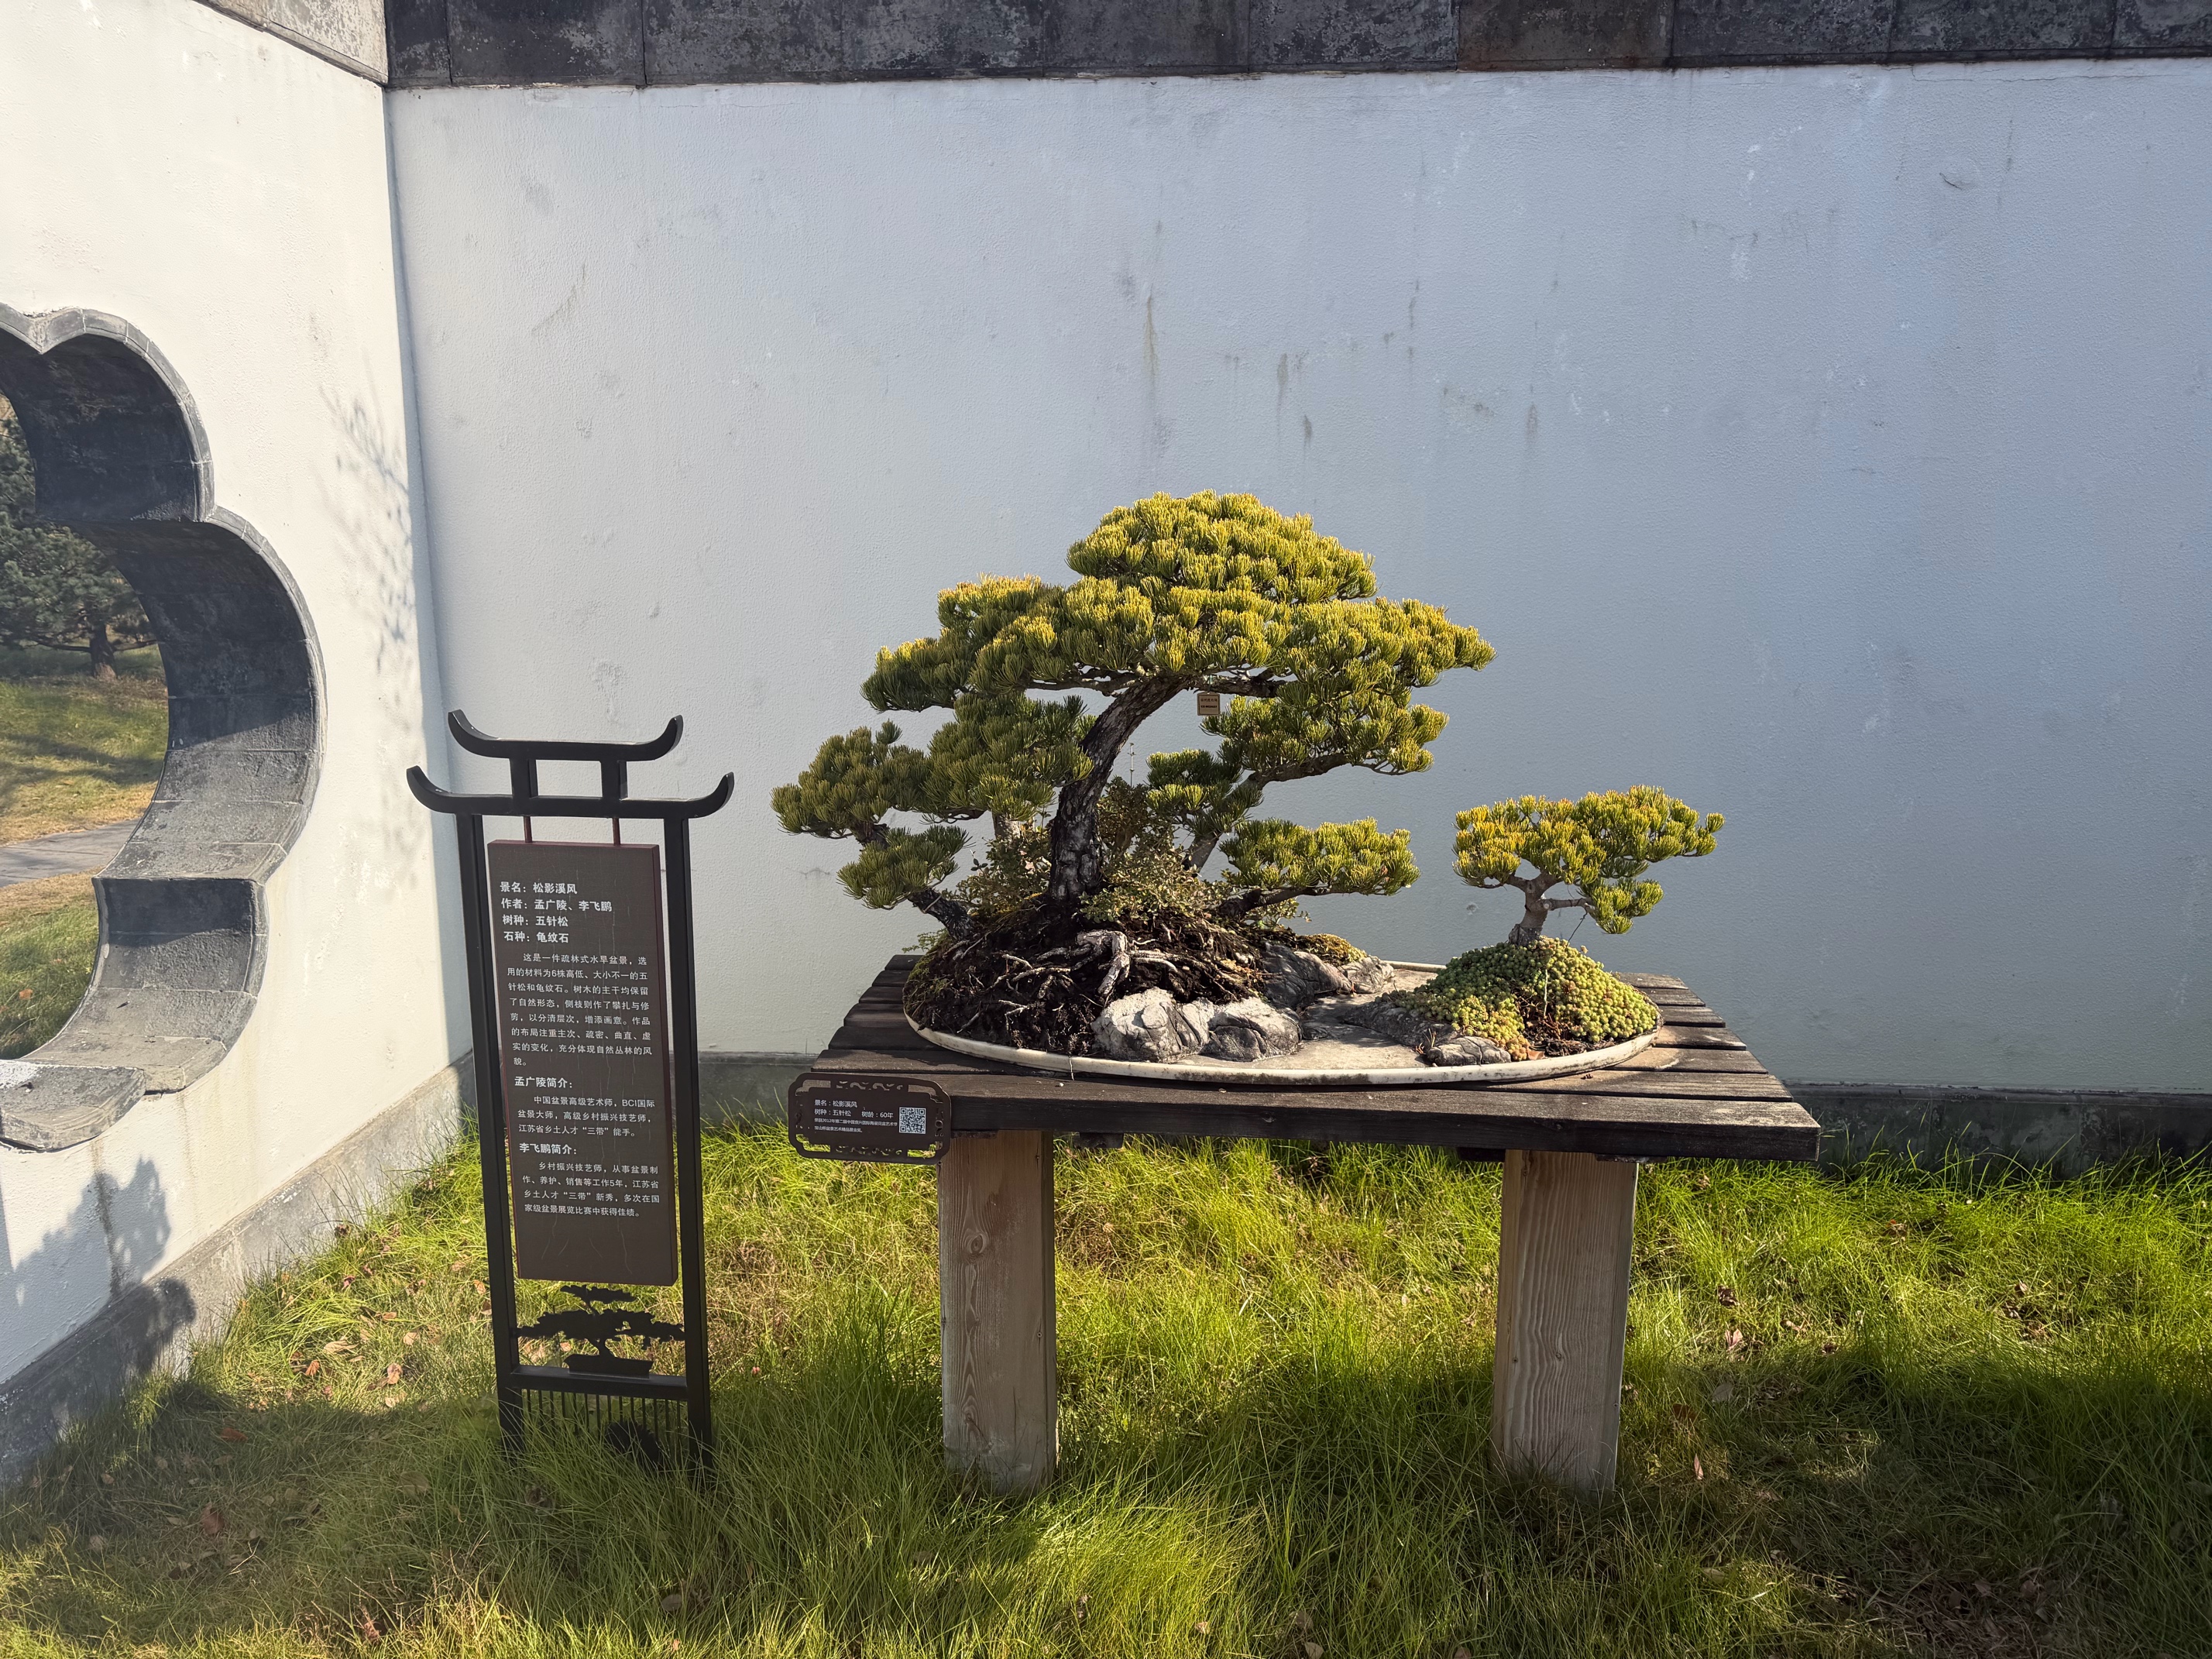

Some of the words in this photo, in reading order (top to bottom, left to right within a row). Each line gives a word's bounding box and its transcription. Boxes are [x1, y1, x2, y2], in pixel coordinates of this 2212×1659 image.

[500, 881, 577, 895] 景名：松影溪风
[501, 898, 613, 912] 作者：孟广陵、李飞鹏
[503, 915, 568, 927] 树种：五针松
[503, 931, 569, 943] 石种：龟纹石
[523, 953, 647, 966] 这是一件疏林式水旱盆景，选
[507, 967, 647, 981] 用的材料为6株高低、大小不一的五
[508, 983, 648, 996] 针松和龟纹石。树木的主干均保留
[509, 998, 650, 1010] 了自然形态，侧枝则作了攀扎与修
[510, 1012, 651, 1025] 剪，以分清层次，增添画意。作品
[511, 1028, 651, 1040] 的布局注重主次、疏密、曲直、虚
[513, 1043, 652, 1056] 实的变化，充分体现自然丛林的风
[514, 1057, 527, 1066] 貌。
[514, 1076, 573, 1089] 孟广陵简介：
[534, 1095, 655, 1108] 中国盆景高级艺术师，BCI国际
[814, 1099, 858, 1108] 景名：松影溪风
[517, 1110, 651, 1122] 盆景大师，高级乡村振兴技艺师，
[814, 1108, 852, 1117] 树种：五针松
[861, 1111, 894, 1119] 树龄：60年
[519, 1142, 577, 1156] 李飞鹏简介：
[538, 1162, 658, 1174] 乡村振兴技艺师，从事盆景制
[522, 1176, 659, 1189] 作、养护、销售等工作5年，江苏省
[524, 1204, 640, 1218] 家级盆景展览比赛中获得佳绩。
